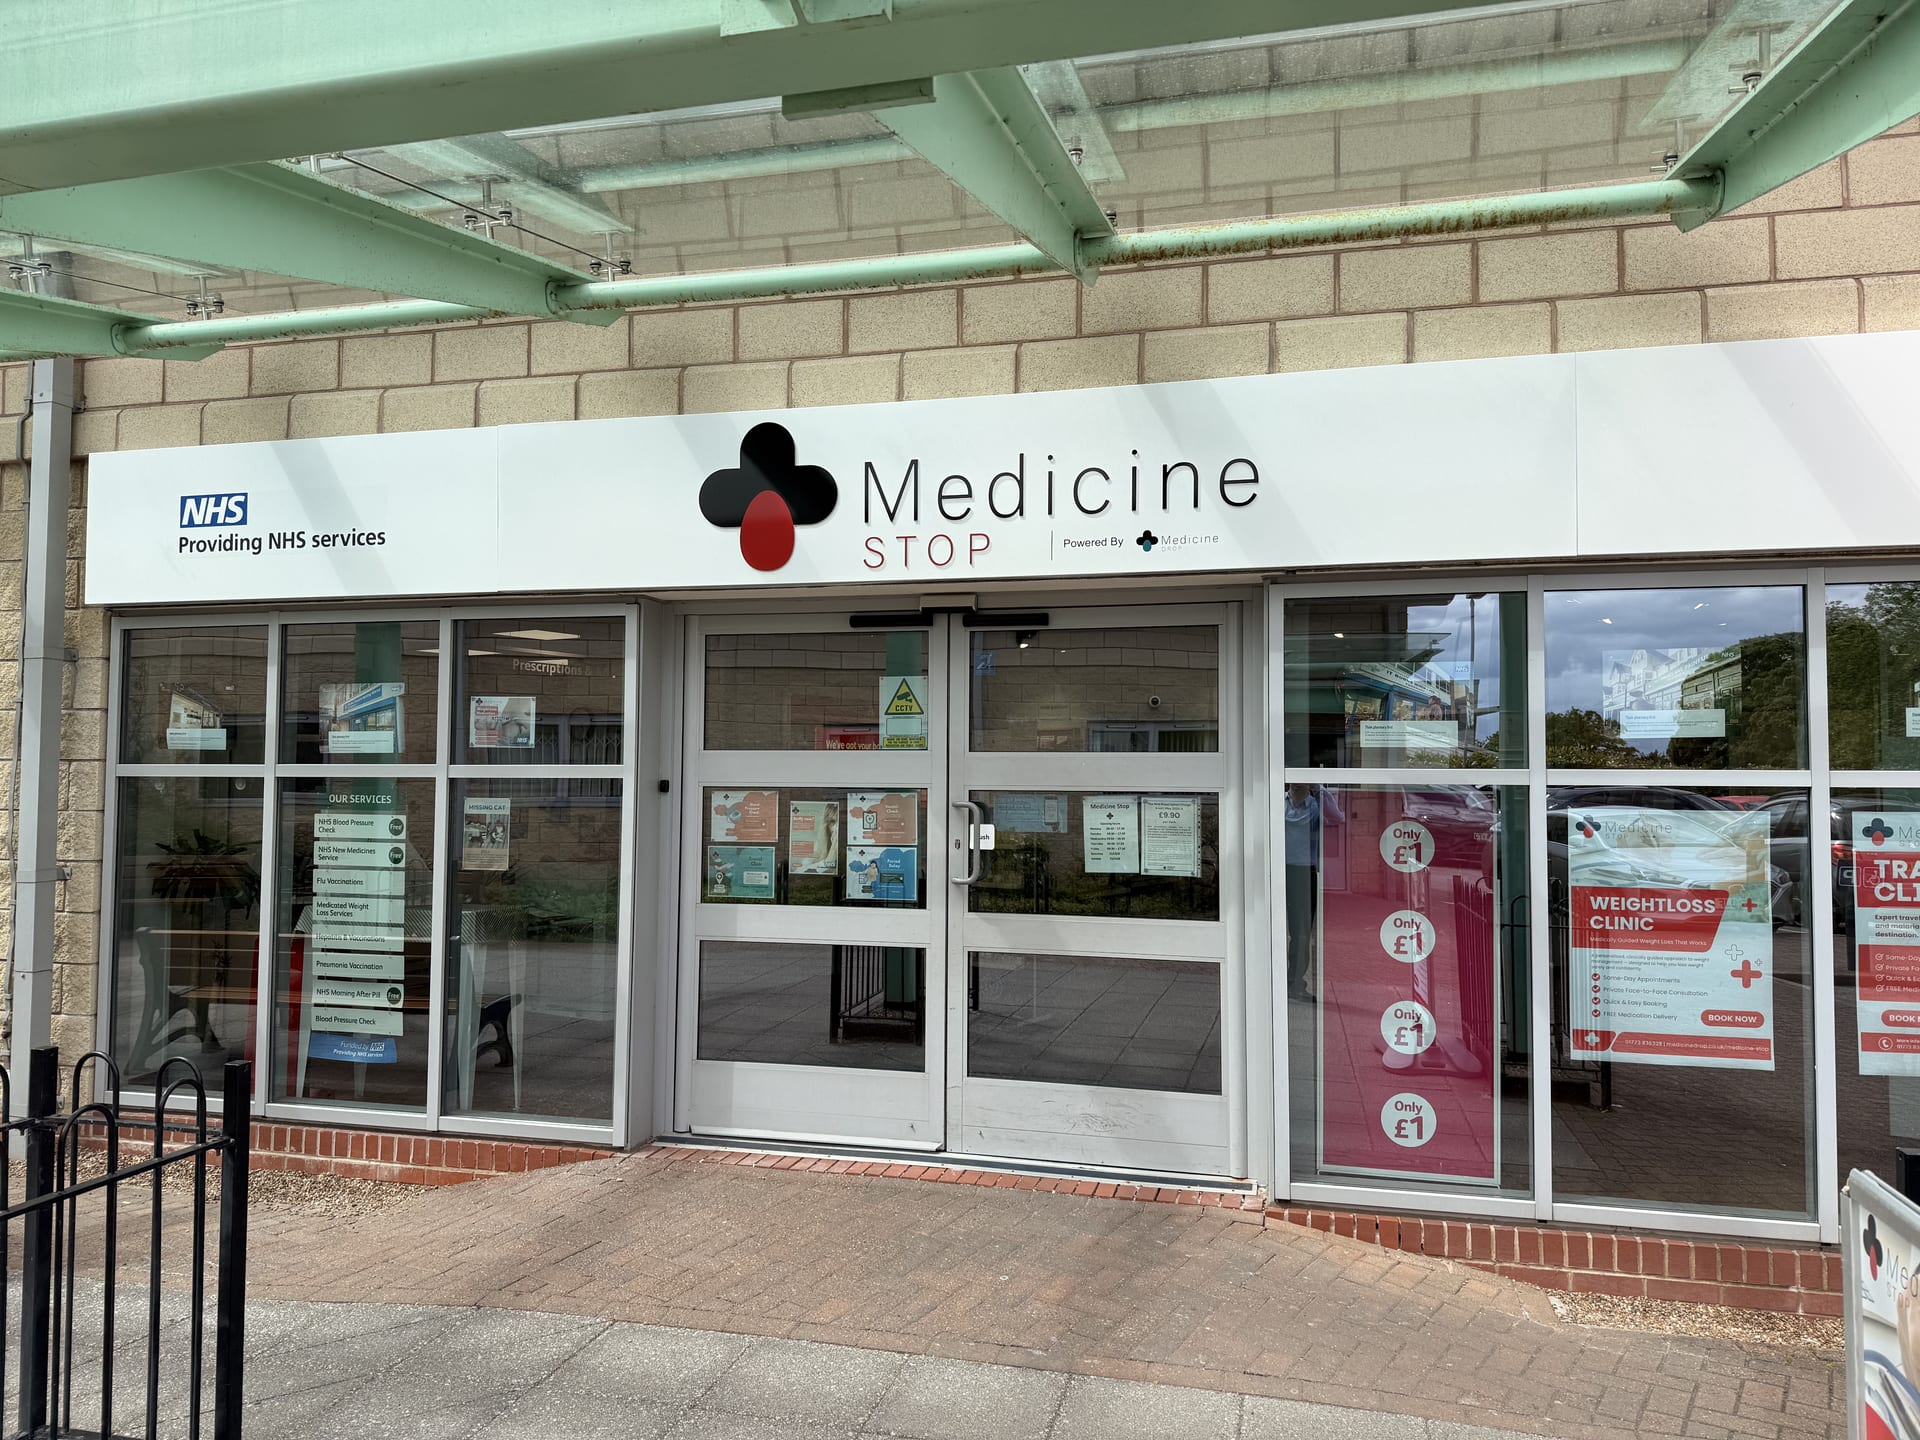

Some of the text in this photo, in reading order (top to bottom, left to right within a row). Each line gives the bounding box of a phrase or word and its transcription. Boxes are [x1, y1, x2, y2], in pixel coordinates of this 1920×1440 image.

[864, 449, 1259, 524] Medicine
[181, 495, 245, 526] NHS
[179, 528, 386, 555] Providing NHS services
[1063, 537, 1124, 548] Powered By
[1161, 535, 1219, 545] Medicine
[863, 533, 991, 569] STOP
[512, 658, 582, 676] Prescriptions
[329, 794, 392, 804] OUR SERVICES
[350, 819, 374, 827] Pressure
[1605, 820, 1672, 834] Medicine
[1393, 828, 1421, 842] Only
[1393, 842, 1422, 864] £1
[1874, 859, 1920, 879] TRA
[348, 903, 369, 911] Weight
[1590, 896, 1716, 914] WEIGHTLOSS
[1393, 918, 1422, 931] Only
[1590, 916, 1654, 931] CLINIC
[1394, 932, 1422, 956] £1
[349, 962, 383, 970] Vaccination
[331, 990, 355, 998] Morning
[334, 1016, 357, 1024] Pressure
[1394, 1008, 1422, 1023] Only
[1653, 1013, 1677, 1021] Delivery
[1708, 1014, 1757, 1024] BOOK NOW
[1889, 1014, 1916, 1023] BOOK
[1394, 1024, 1423, 1047] £1
[341, 1041, 363, 1049] Funded
[333, 1049, 356, 1057] Providing
[1394, 1100, 1422, 1115] Only
[1394, 1116, 1423, 1140] £1
